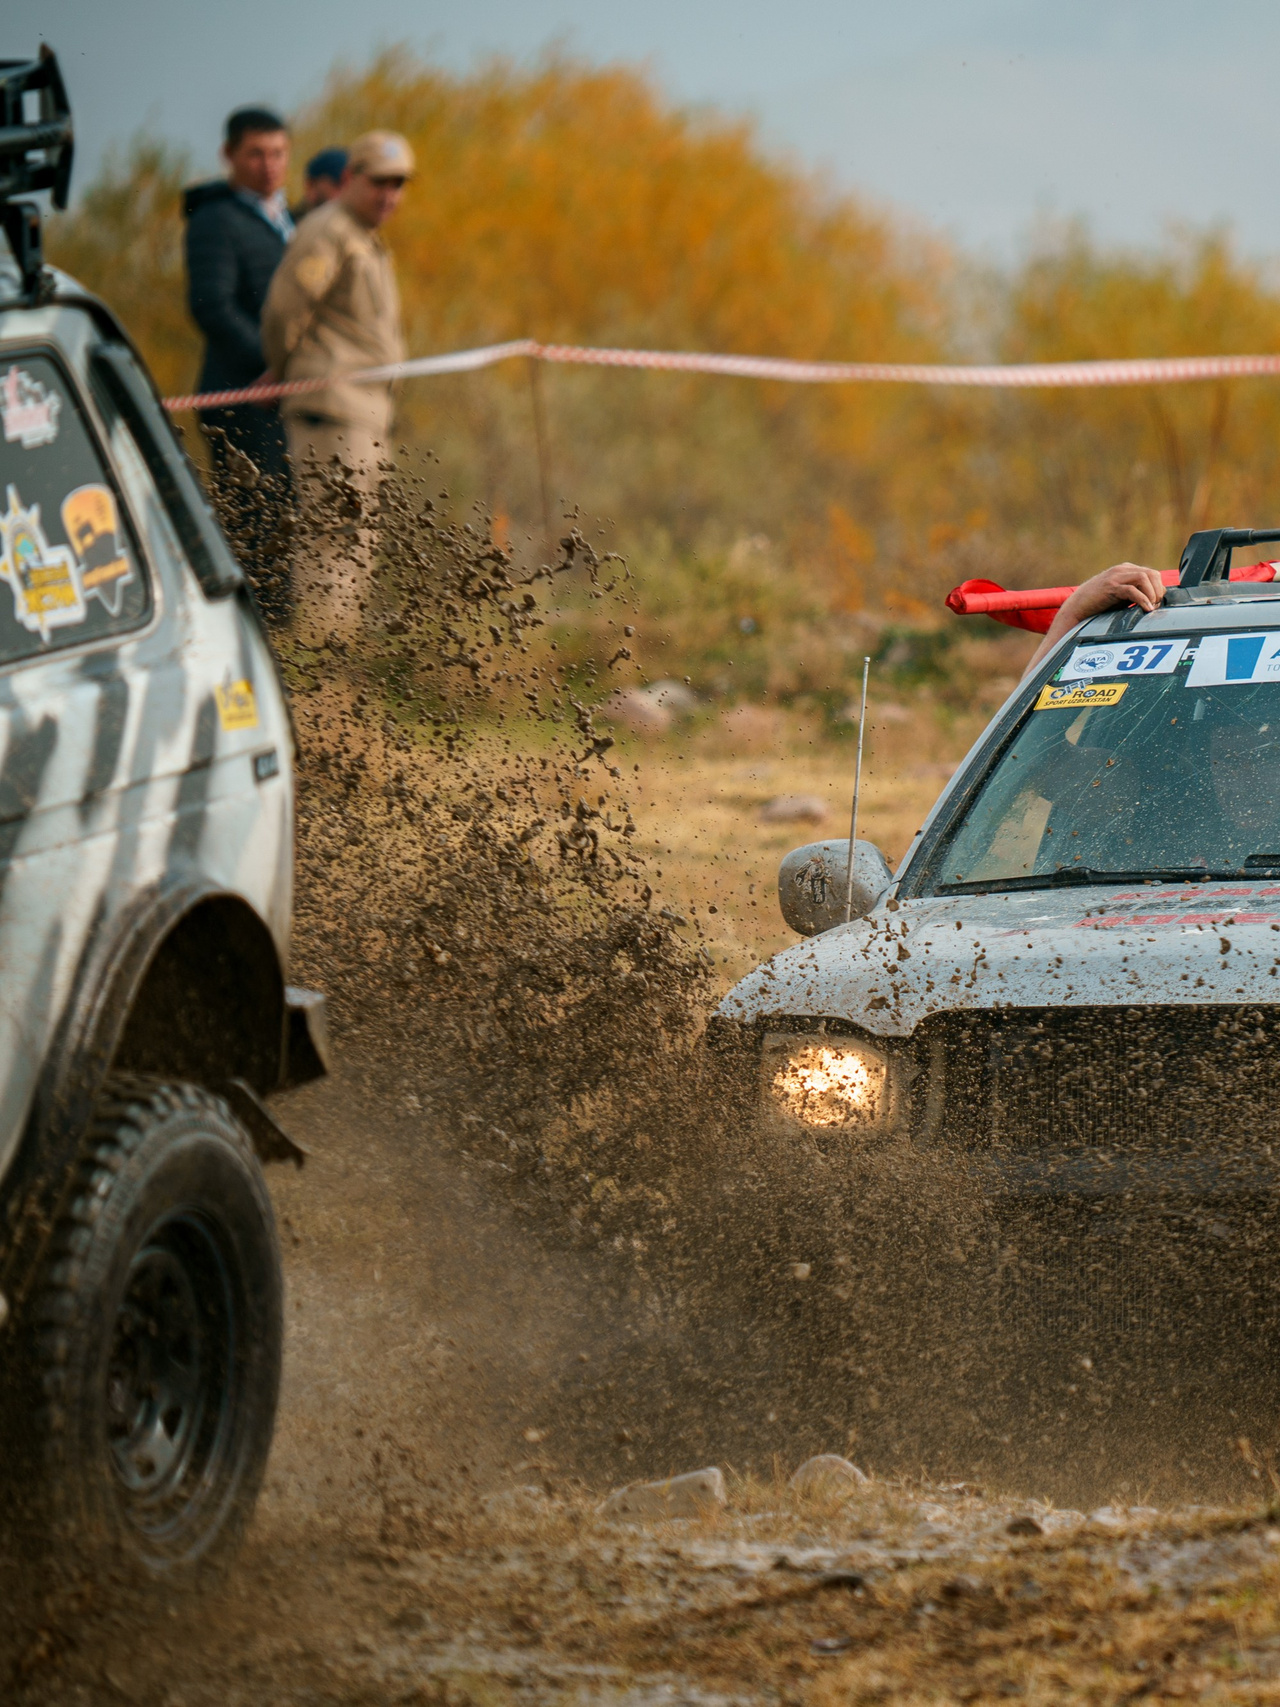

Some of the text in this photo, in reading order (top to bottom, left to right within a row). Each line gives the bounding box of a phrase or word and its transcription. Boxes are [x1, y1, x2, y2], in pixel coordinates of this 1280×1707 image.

[1117, 644, 1174, 671] 37
[1050, 677, 1117, 699] OFF ROAD
